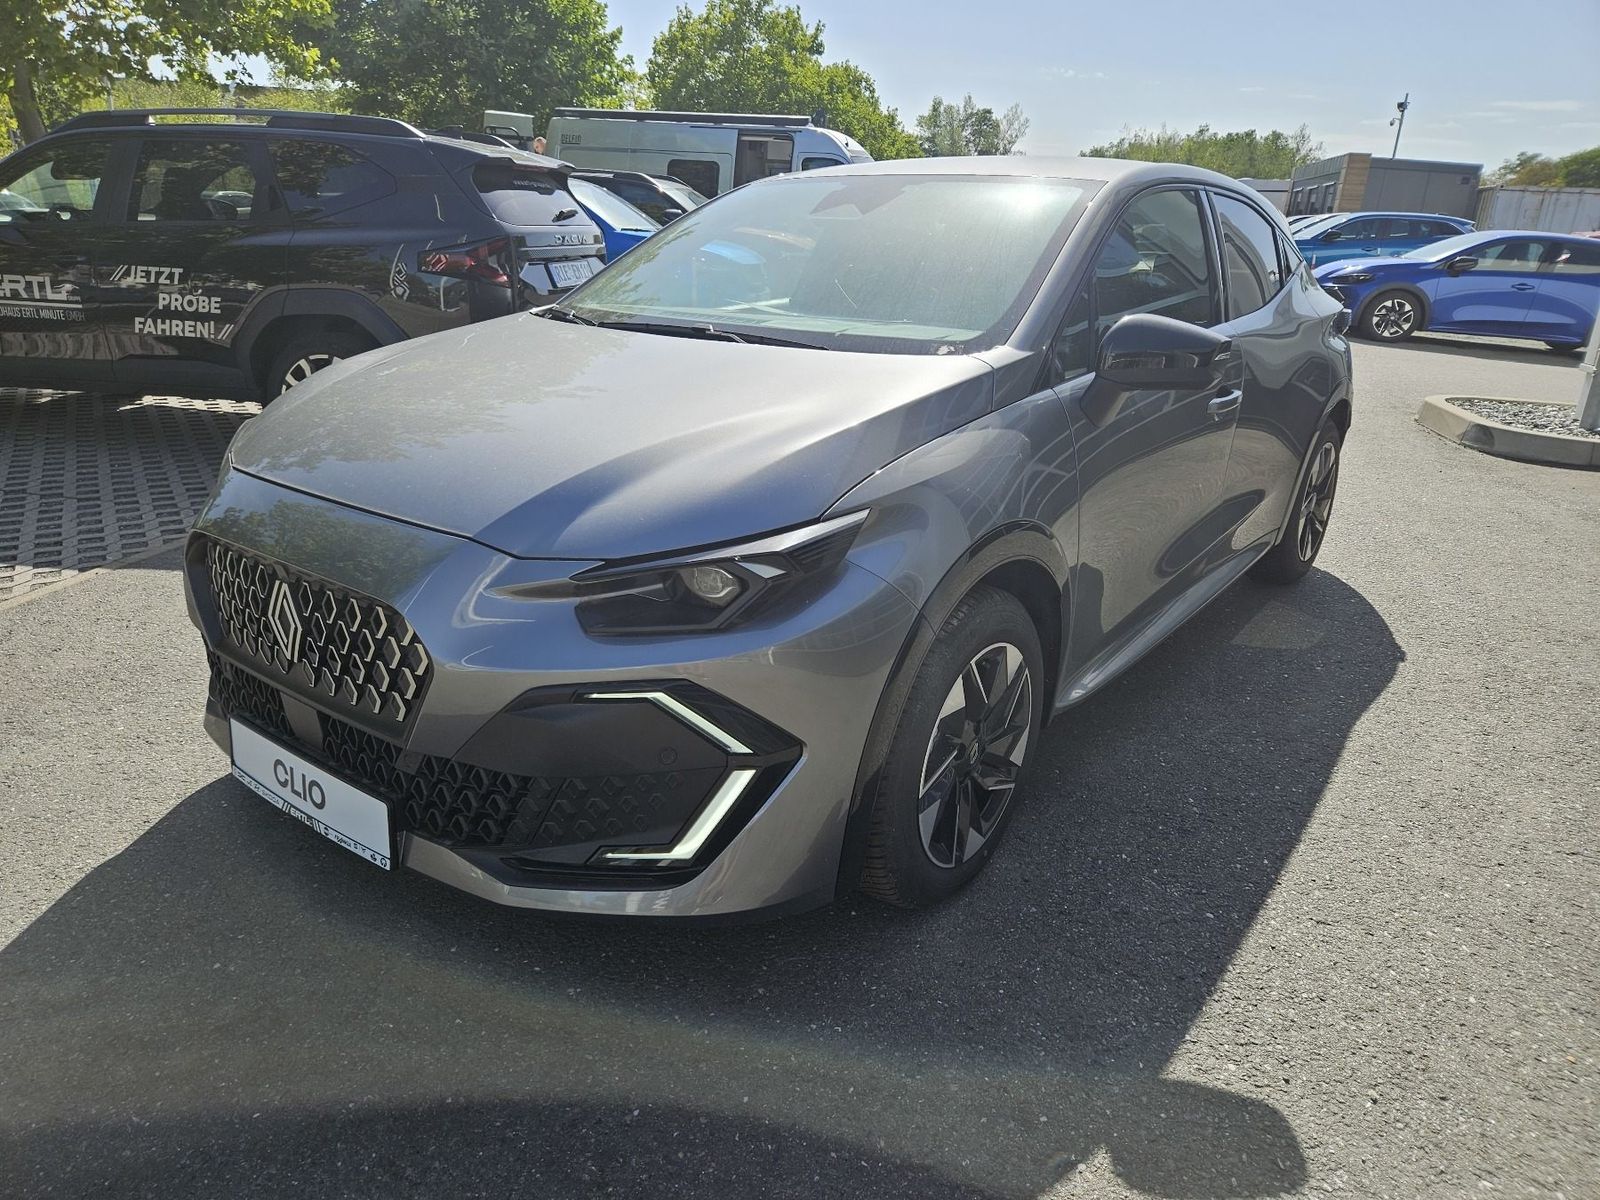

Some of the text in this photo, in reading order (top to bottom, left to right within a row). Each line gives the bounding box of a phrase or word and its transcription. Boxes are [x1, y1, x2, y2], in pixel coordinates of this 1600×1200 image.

[0, 274, 67, 301] RTL
[20, 307, 39, 319] ERTL
[39, 308, 66, 320] MINUTE
[158, 292, 222, 314] PROBE
[273, 758, 326, 810] CLIO
